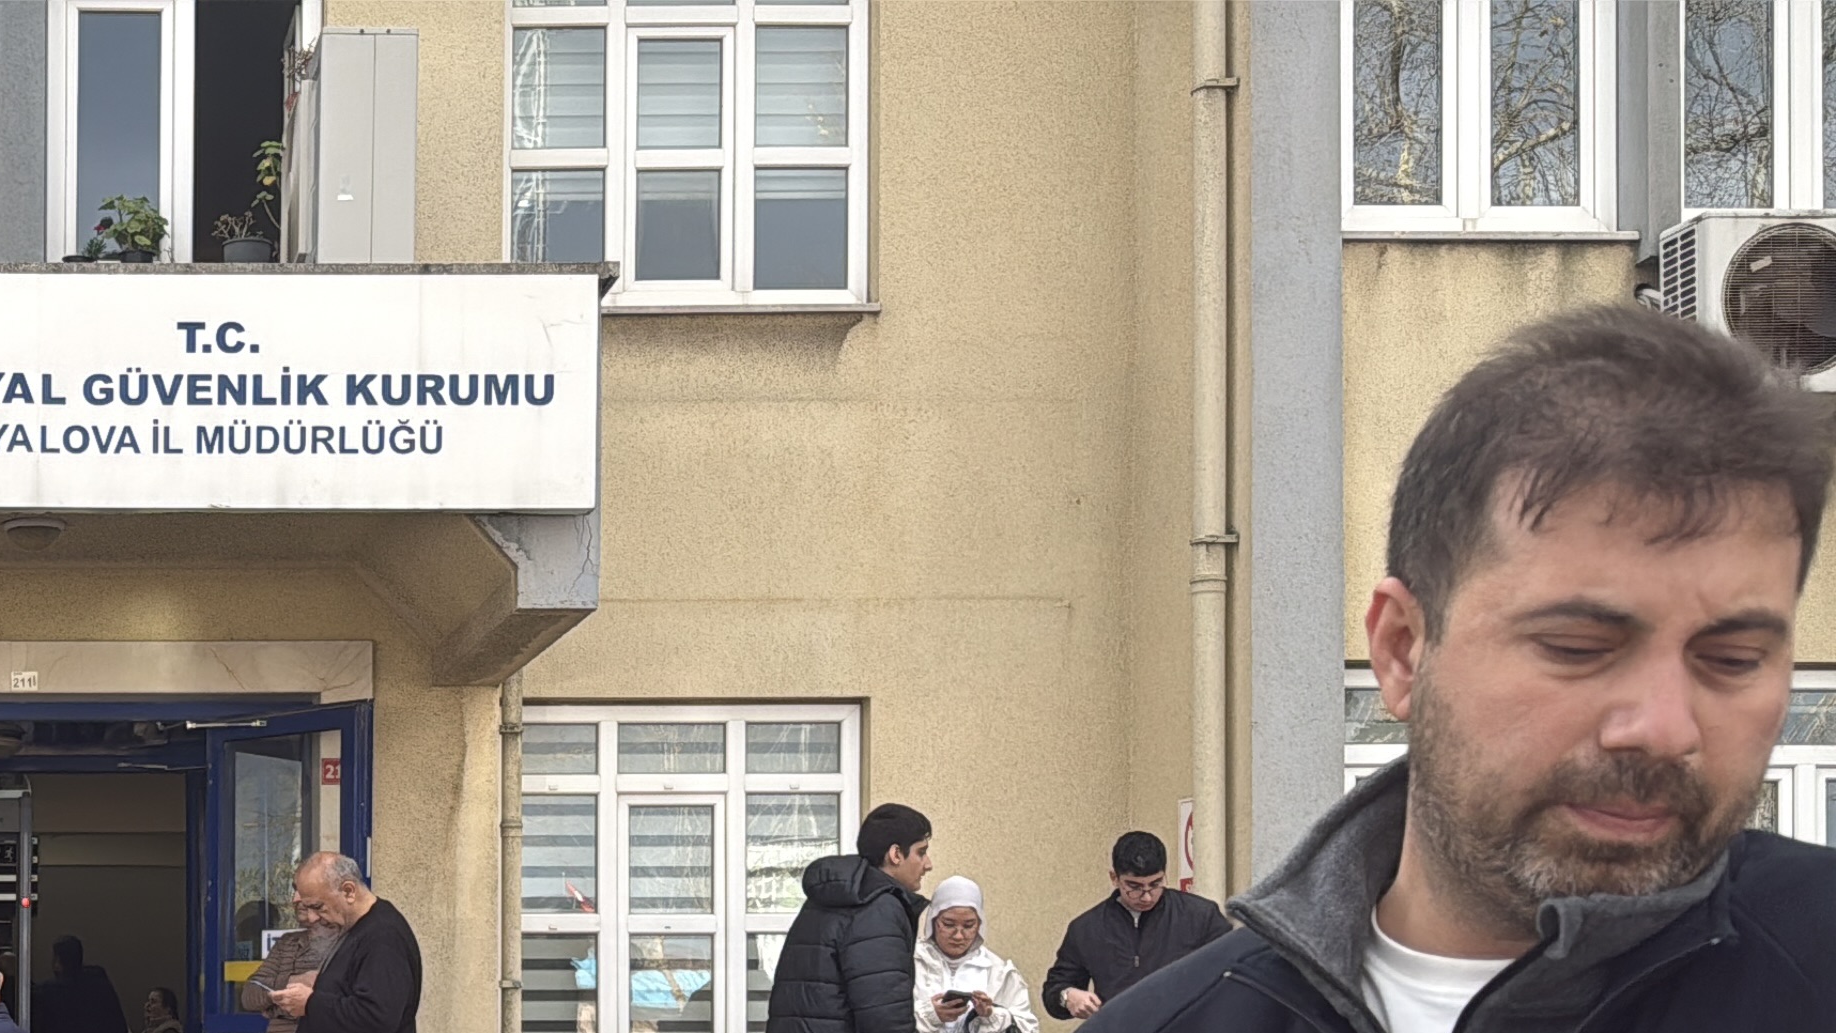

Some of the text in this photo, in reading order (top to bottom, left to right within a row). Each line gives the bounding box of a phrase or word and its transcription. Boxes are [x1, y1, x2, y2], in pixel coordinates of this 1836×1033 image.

[177, 321, 259, 354] T.C.
[83, 366, 328, 405] GÜVENLİK
[347, 374, 554, 406] KURUMU
[152, 419, 183, 453] İL
[197, 419, 443, 454] MÜDÜRLÜĞÜ
